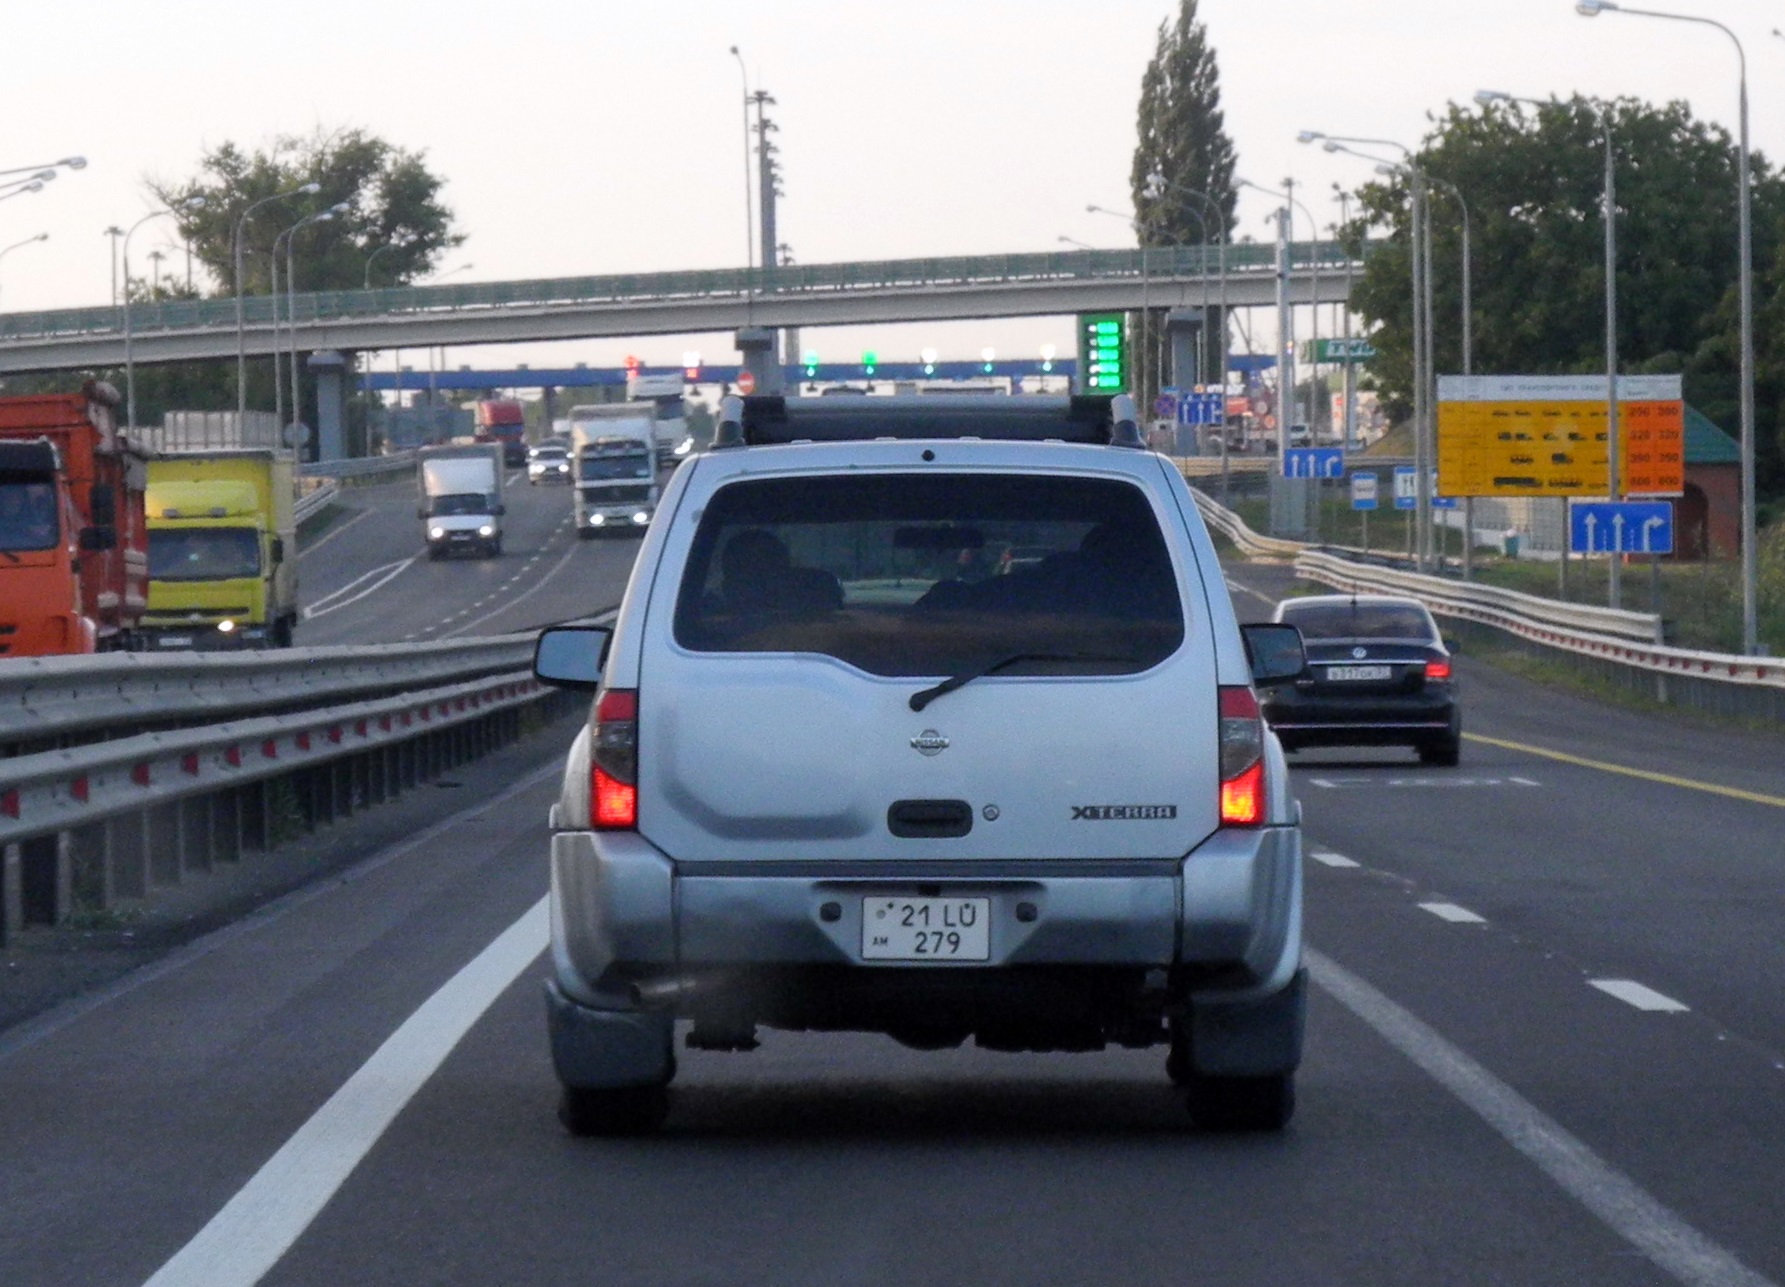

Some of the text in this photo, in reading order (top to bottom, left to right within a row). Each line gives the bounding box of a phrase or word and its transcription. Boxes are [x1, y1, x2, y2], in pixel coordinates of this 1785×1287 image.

[1071, 805, 1177, 820] XTERRA
[901, 904, 976, 927] 21 LU
[872, 936, 889, 946] AM
[915, 931, 961, 954] 279
